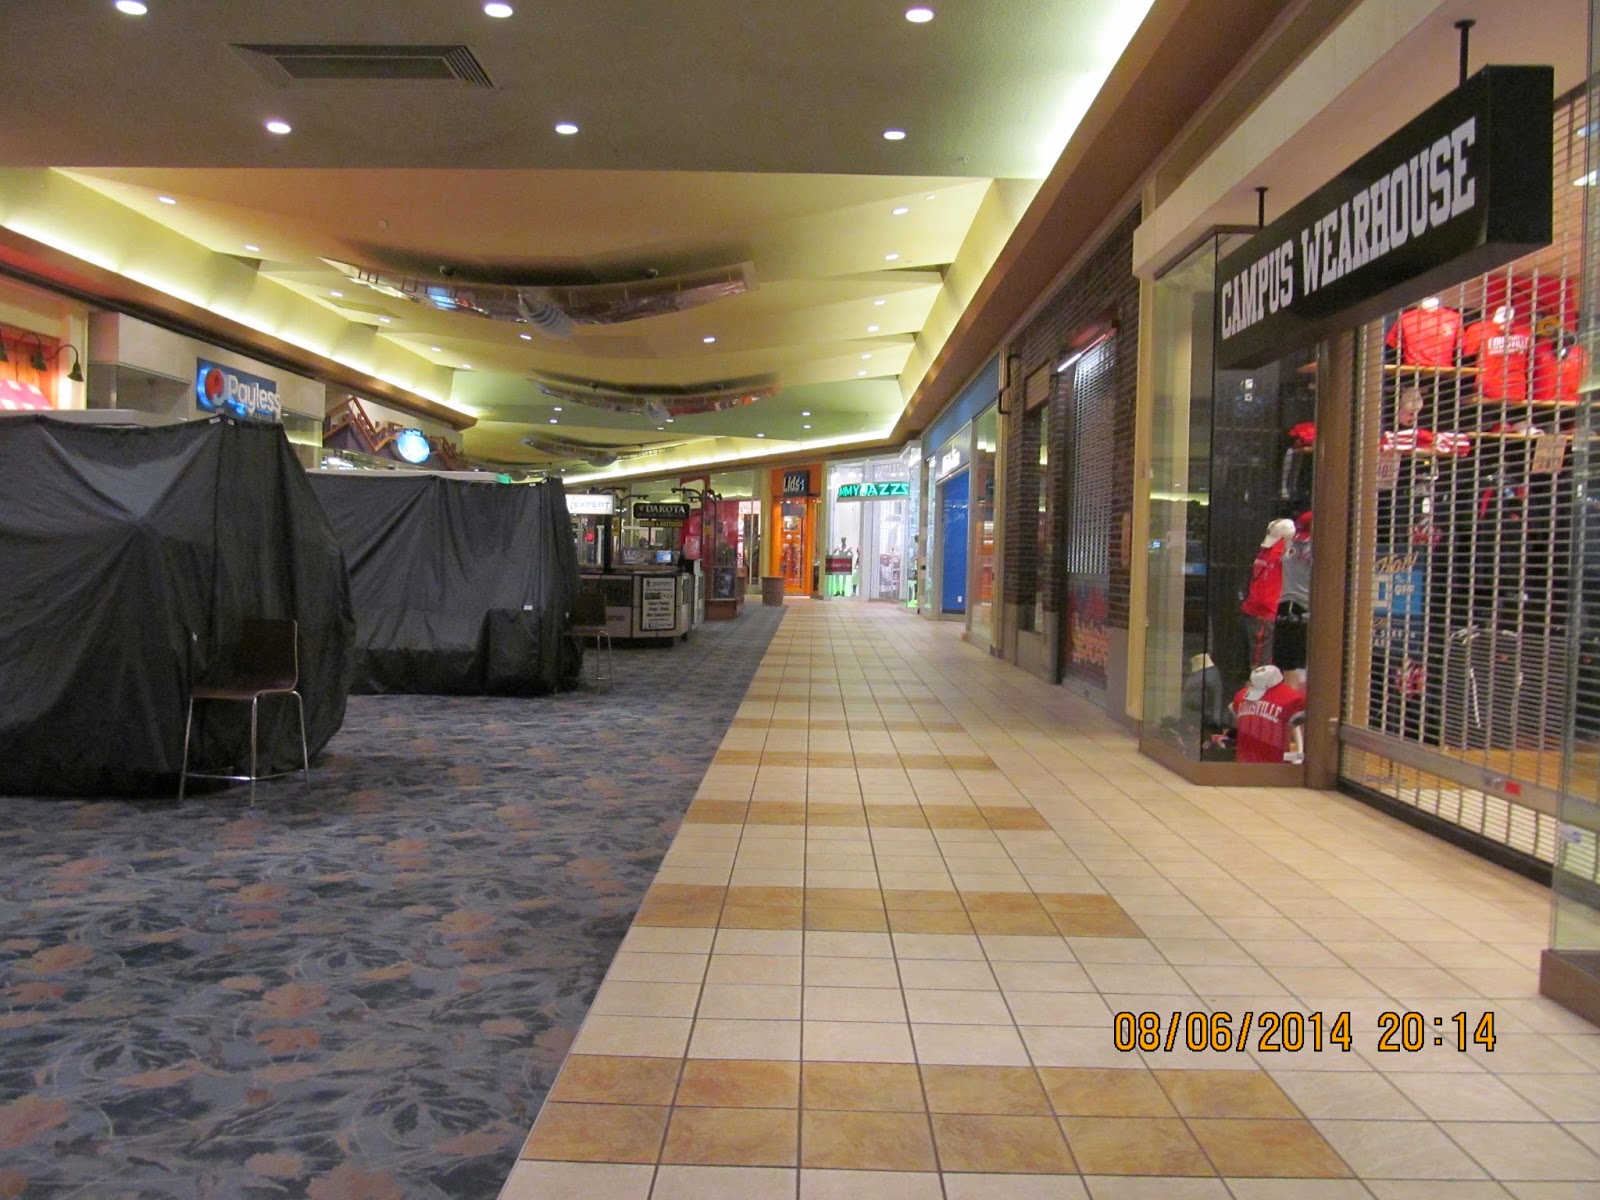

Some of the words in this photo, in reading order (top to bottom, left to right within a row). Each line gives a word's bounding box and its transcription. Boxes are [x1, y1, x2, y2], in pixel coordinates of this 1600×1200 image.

[1221, 239, 1294, 341] CAMPUS
[1300, 115, 1476, 297] WEARHOUSE
[227, 374, 281, 412] Payless
[645, 505, 686, 513] DAKOTA
